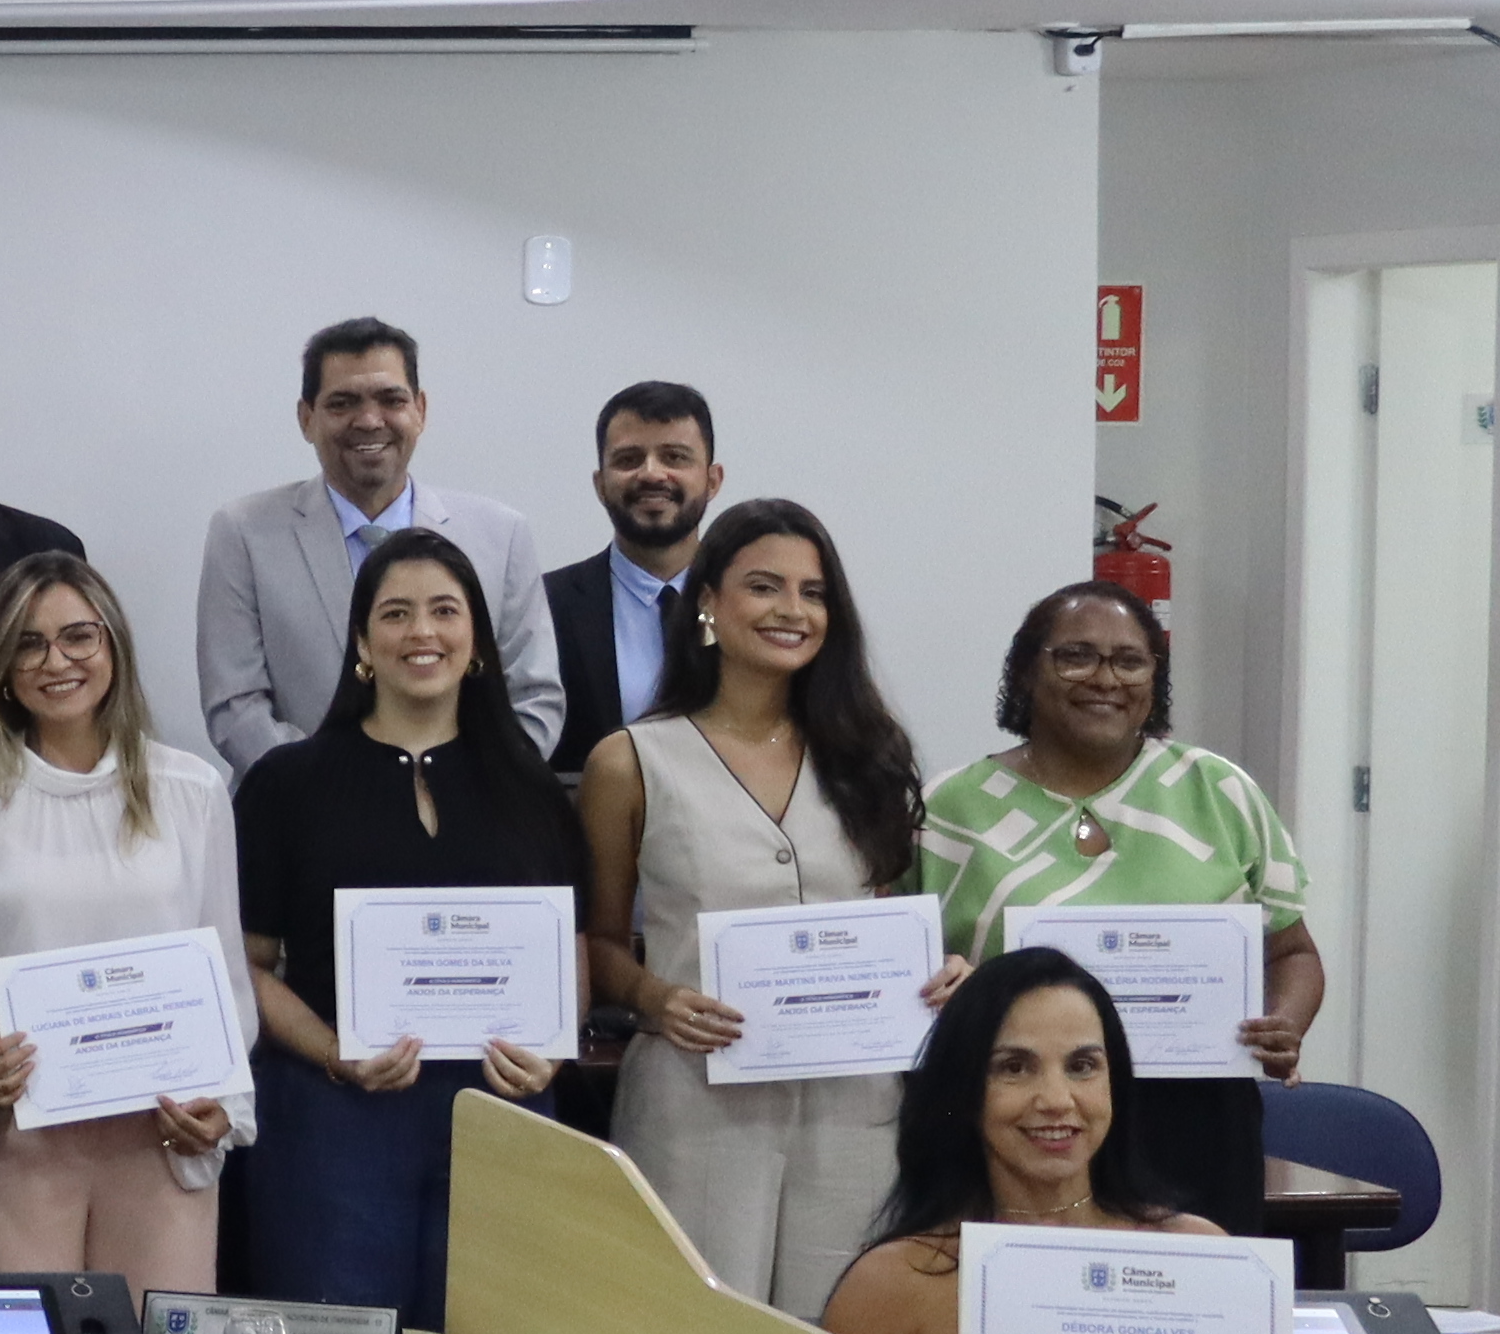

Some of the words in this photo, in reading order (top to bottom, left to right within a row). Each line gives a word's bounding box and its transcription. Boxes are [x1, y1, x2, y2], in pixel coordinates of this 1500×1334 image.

[1097, 347, 1136, 356] TINTOR
[1122, 1267, 1163, 1278] Câmara
[1122, 1278, 1175, 1290] Municipal
